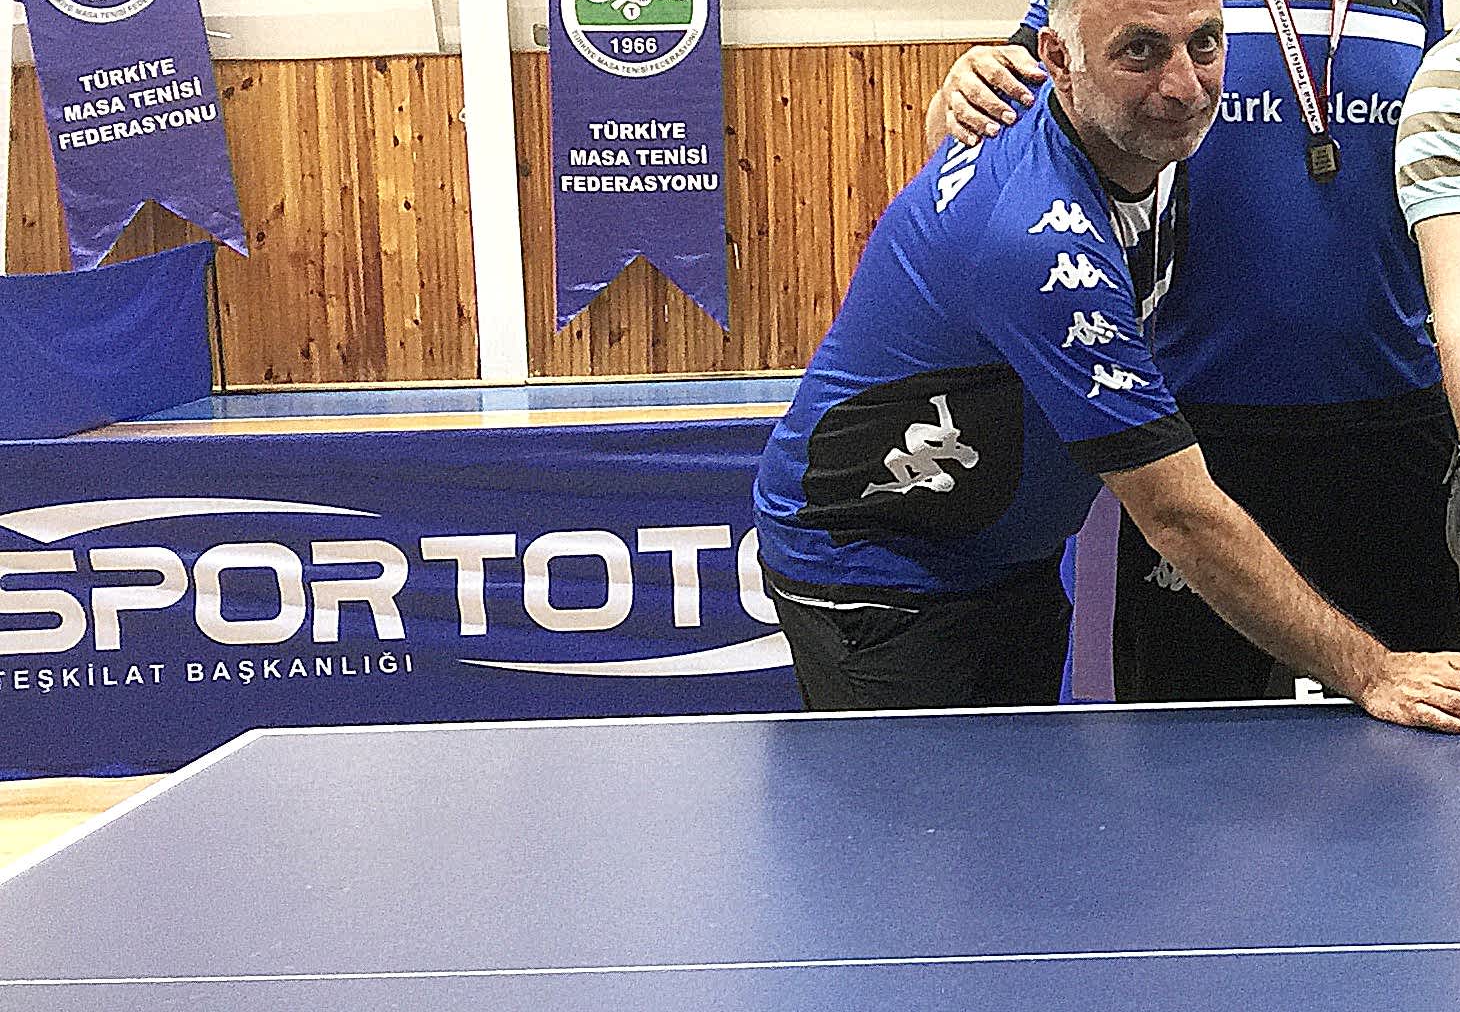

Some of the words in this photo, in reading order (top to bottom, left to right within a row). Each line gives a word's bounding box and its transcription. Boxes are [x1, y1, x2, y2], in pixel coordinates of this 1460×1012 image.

[609, 37, 658, 54] 1966
[79, 58, 176, 92] TÜRKİYE
[63, 96, 126, 123] MASA
[129, 76, 203, 109] TENİSİ
[1221, 90, 1283, 123] ürk
[58, 103, 217, 150] FEDERASYONU
[589, 119, 686, 140] TÜRKİYE
[570, 149, 631, 166] MASA
[635, 144, 708, 166] TENİSİ
[560, 174, 719, 192] FEDERASYONU
[186, 651, 413, 686] BAŞKANLIĞI
